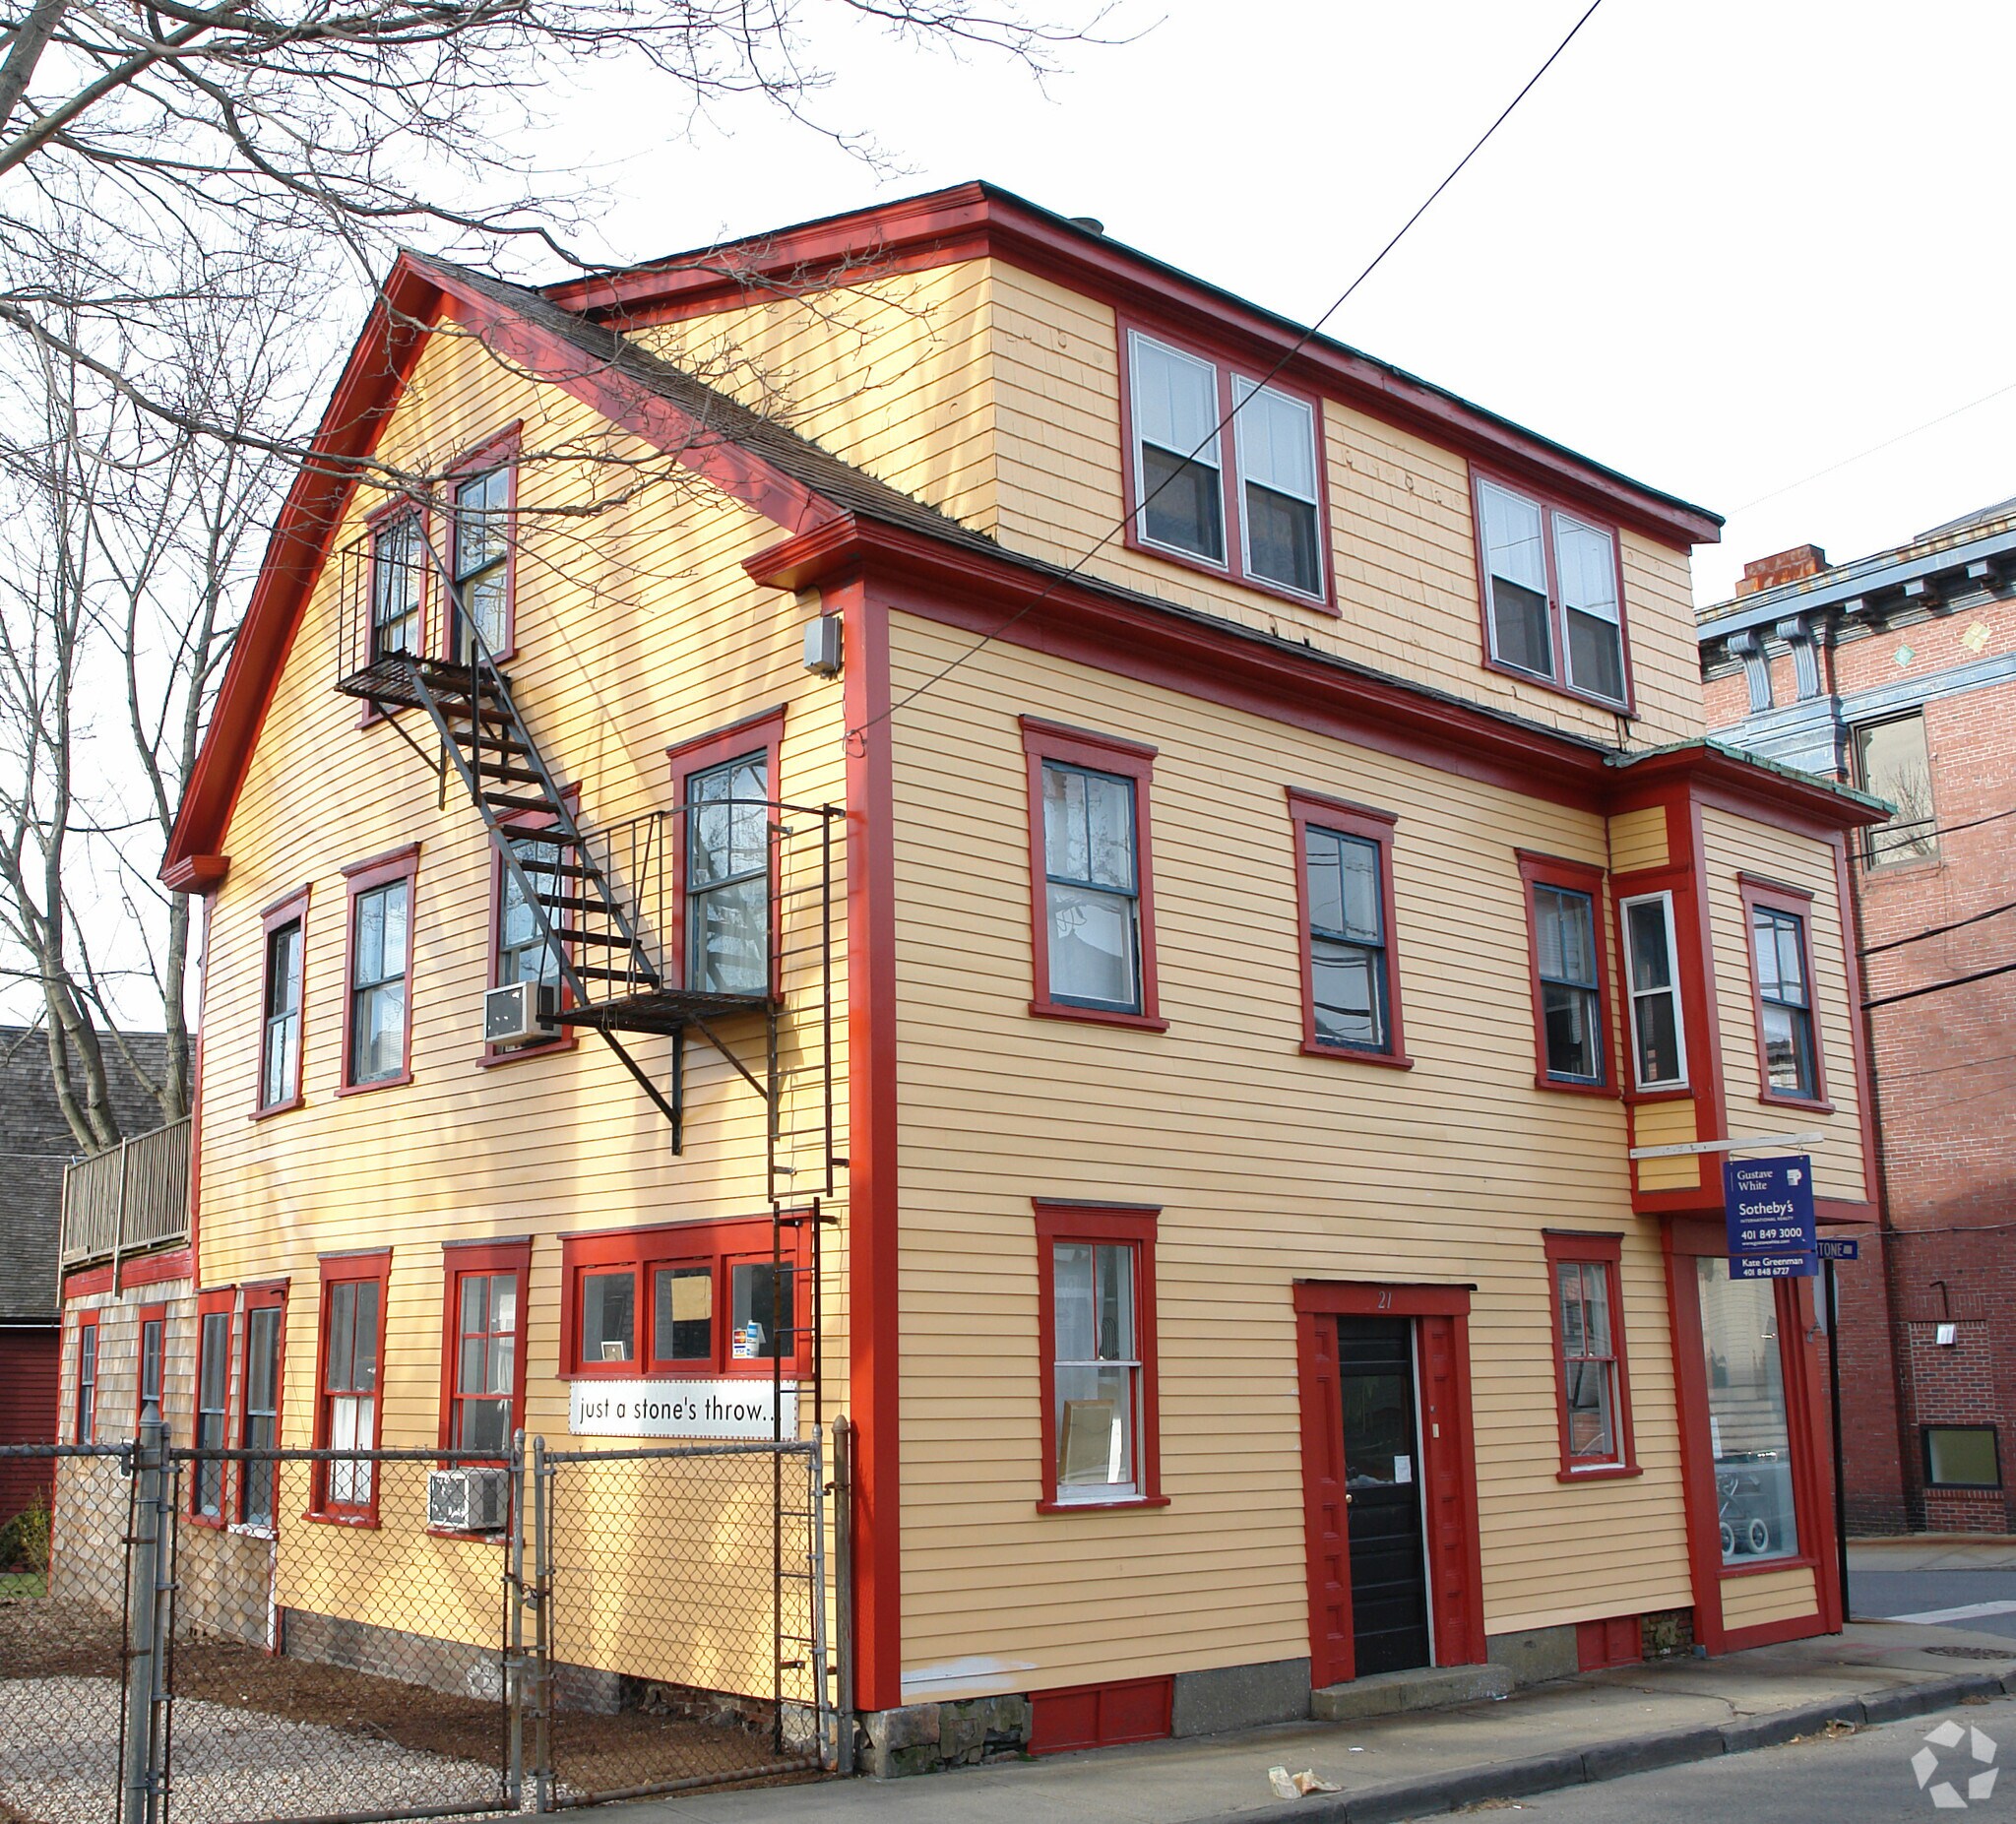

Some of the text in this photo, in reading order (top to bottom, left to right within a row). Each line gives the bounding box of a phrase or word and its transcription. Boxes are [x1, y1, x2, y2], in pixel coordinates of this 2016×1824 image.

[1737, 1170, 1773, 1180] Gustave
[1738, 1181, 1767, 1191] White
[1739, 1199, 1794, 1216] Sotheby's
[1741, 1227, 1802, 1240] 401 849 3000
[1817, 1243, 1843, 1257] TONE
[1741, 1257, 1803, 1267] Kate Greenman
[1742, 1268, 1755, 1277] 401
[1772, 1267, 1790, 1276] 6727
[1377, 1290, 1391, 1309] 21
[580, 1398, 609, 1423] just
[616, 1402, 626, 1418] a
[633, 1396, 696, 1420] stone's
